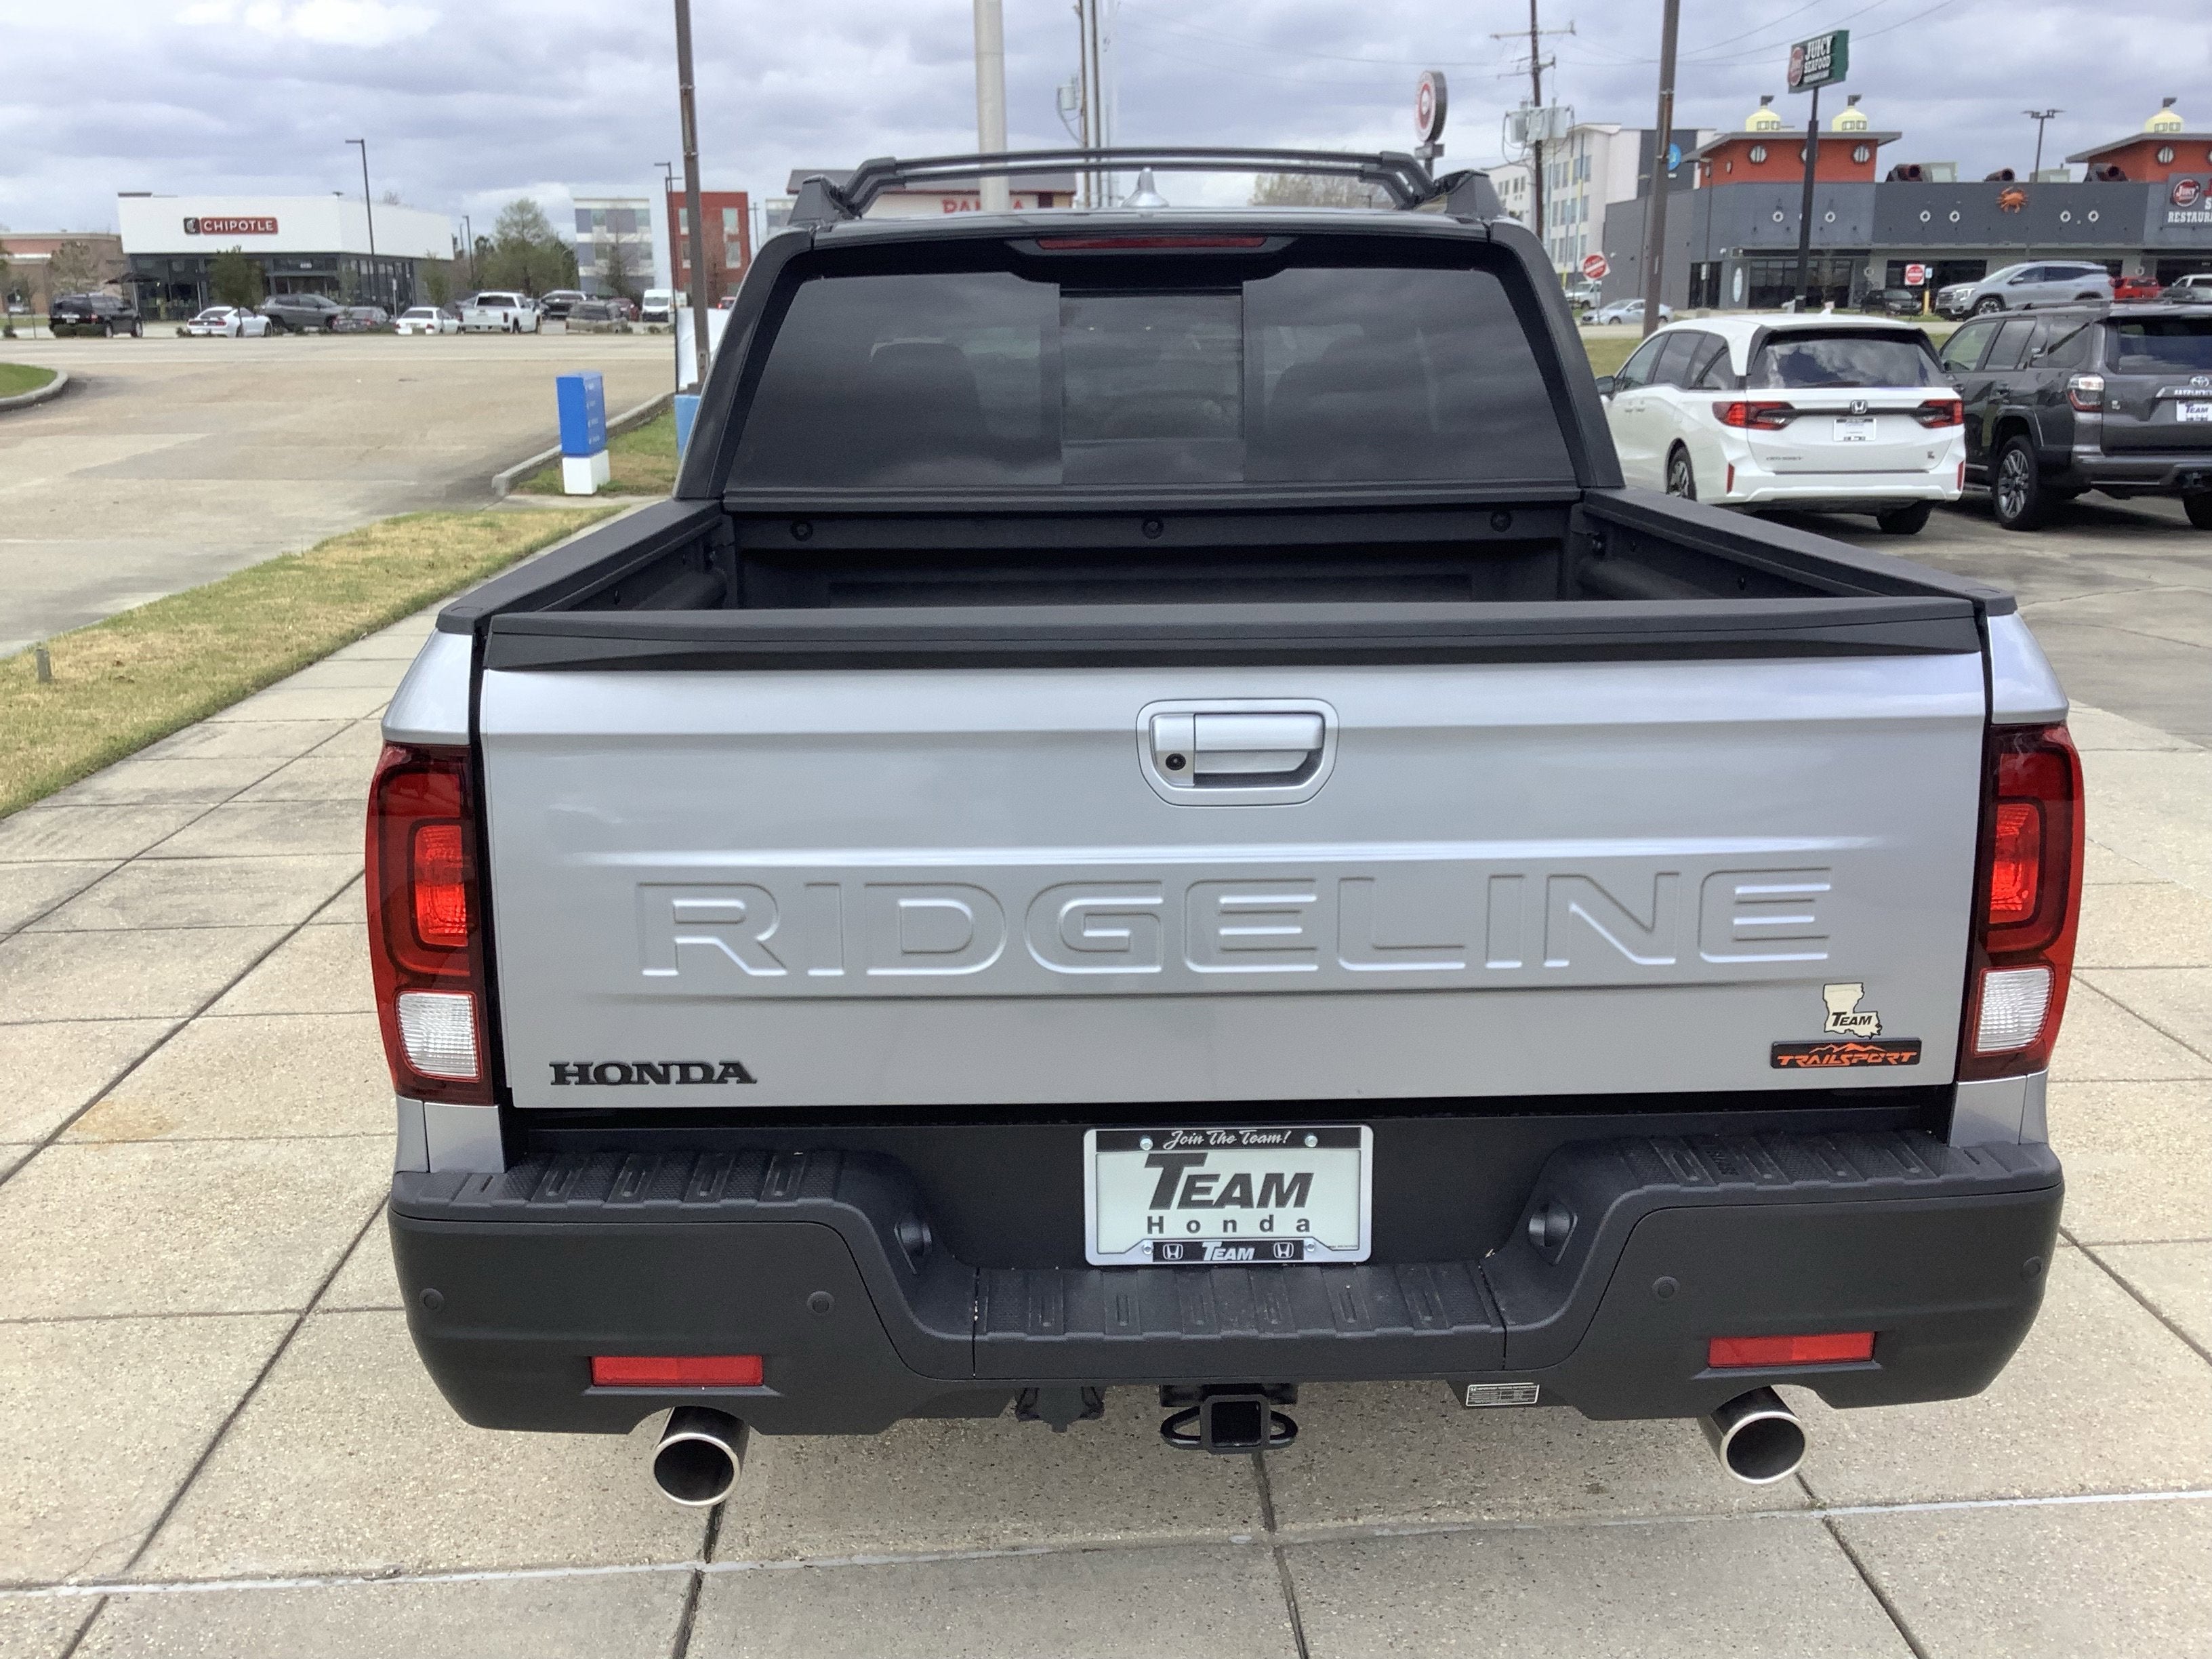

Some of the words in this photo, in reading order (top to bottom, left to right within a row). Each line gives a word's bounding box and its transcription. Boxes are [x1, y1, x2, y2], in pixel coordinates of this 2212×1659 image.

[1805, 35, 1832, 61] JUICY
[943, 200, 1023, 213] PAA
[204, 220, 274, 231] CHIPOTLE
[2185, 403, 2209, 413] TEAM
[636, 867, 1831, 977] RIDGELINE
[1832, 1011, 1872, 1027] TEAM
[1777, 1051, 1917, 1068] TRAILSPORT
[549, 1060, 758, 1086] HONDA
[1162, 1130, 1204, 1150] Join
[1206, 1130, 1237, 1145] The
[1239, 1130, 1292, 1145] Team!
[1144, 1153, 1315, 1210] TEAM
[1201, 1241, 1256, 1261] TEAM
